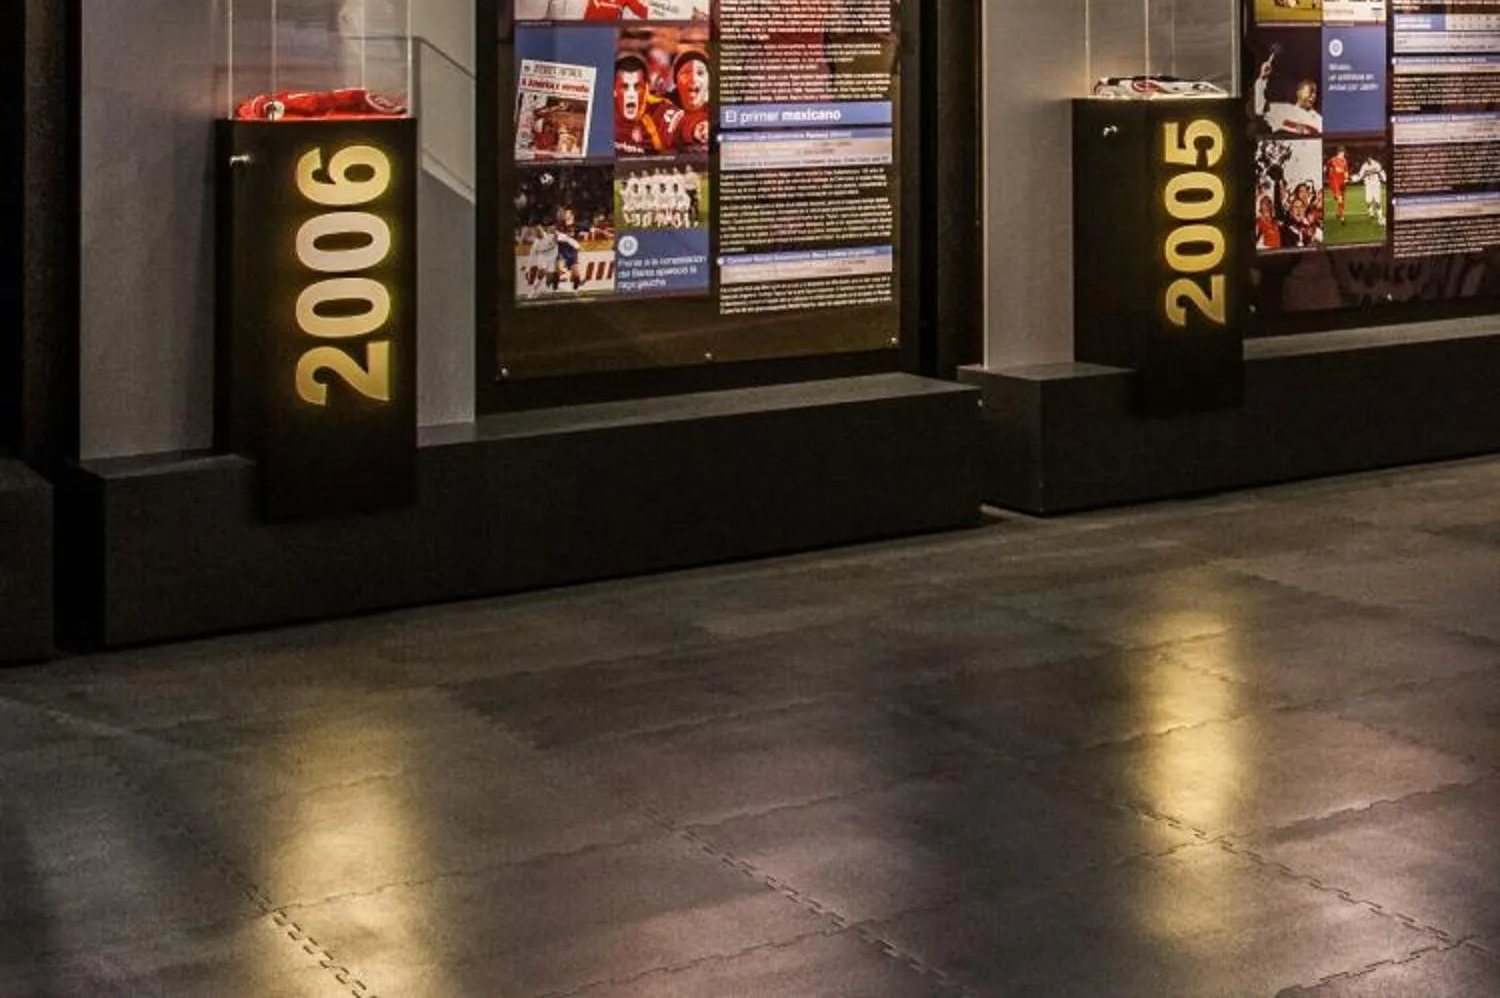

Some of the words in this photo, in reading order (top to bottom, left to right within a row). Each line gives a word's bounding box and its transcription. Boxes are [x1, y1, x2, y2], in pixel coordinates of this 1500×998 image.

[740, 109, 779, 124] primer
[295, 144, 391, 407] 2006
[1163, 118, 1226, 328] 2005
